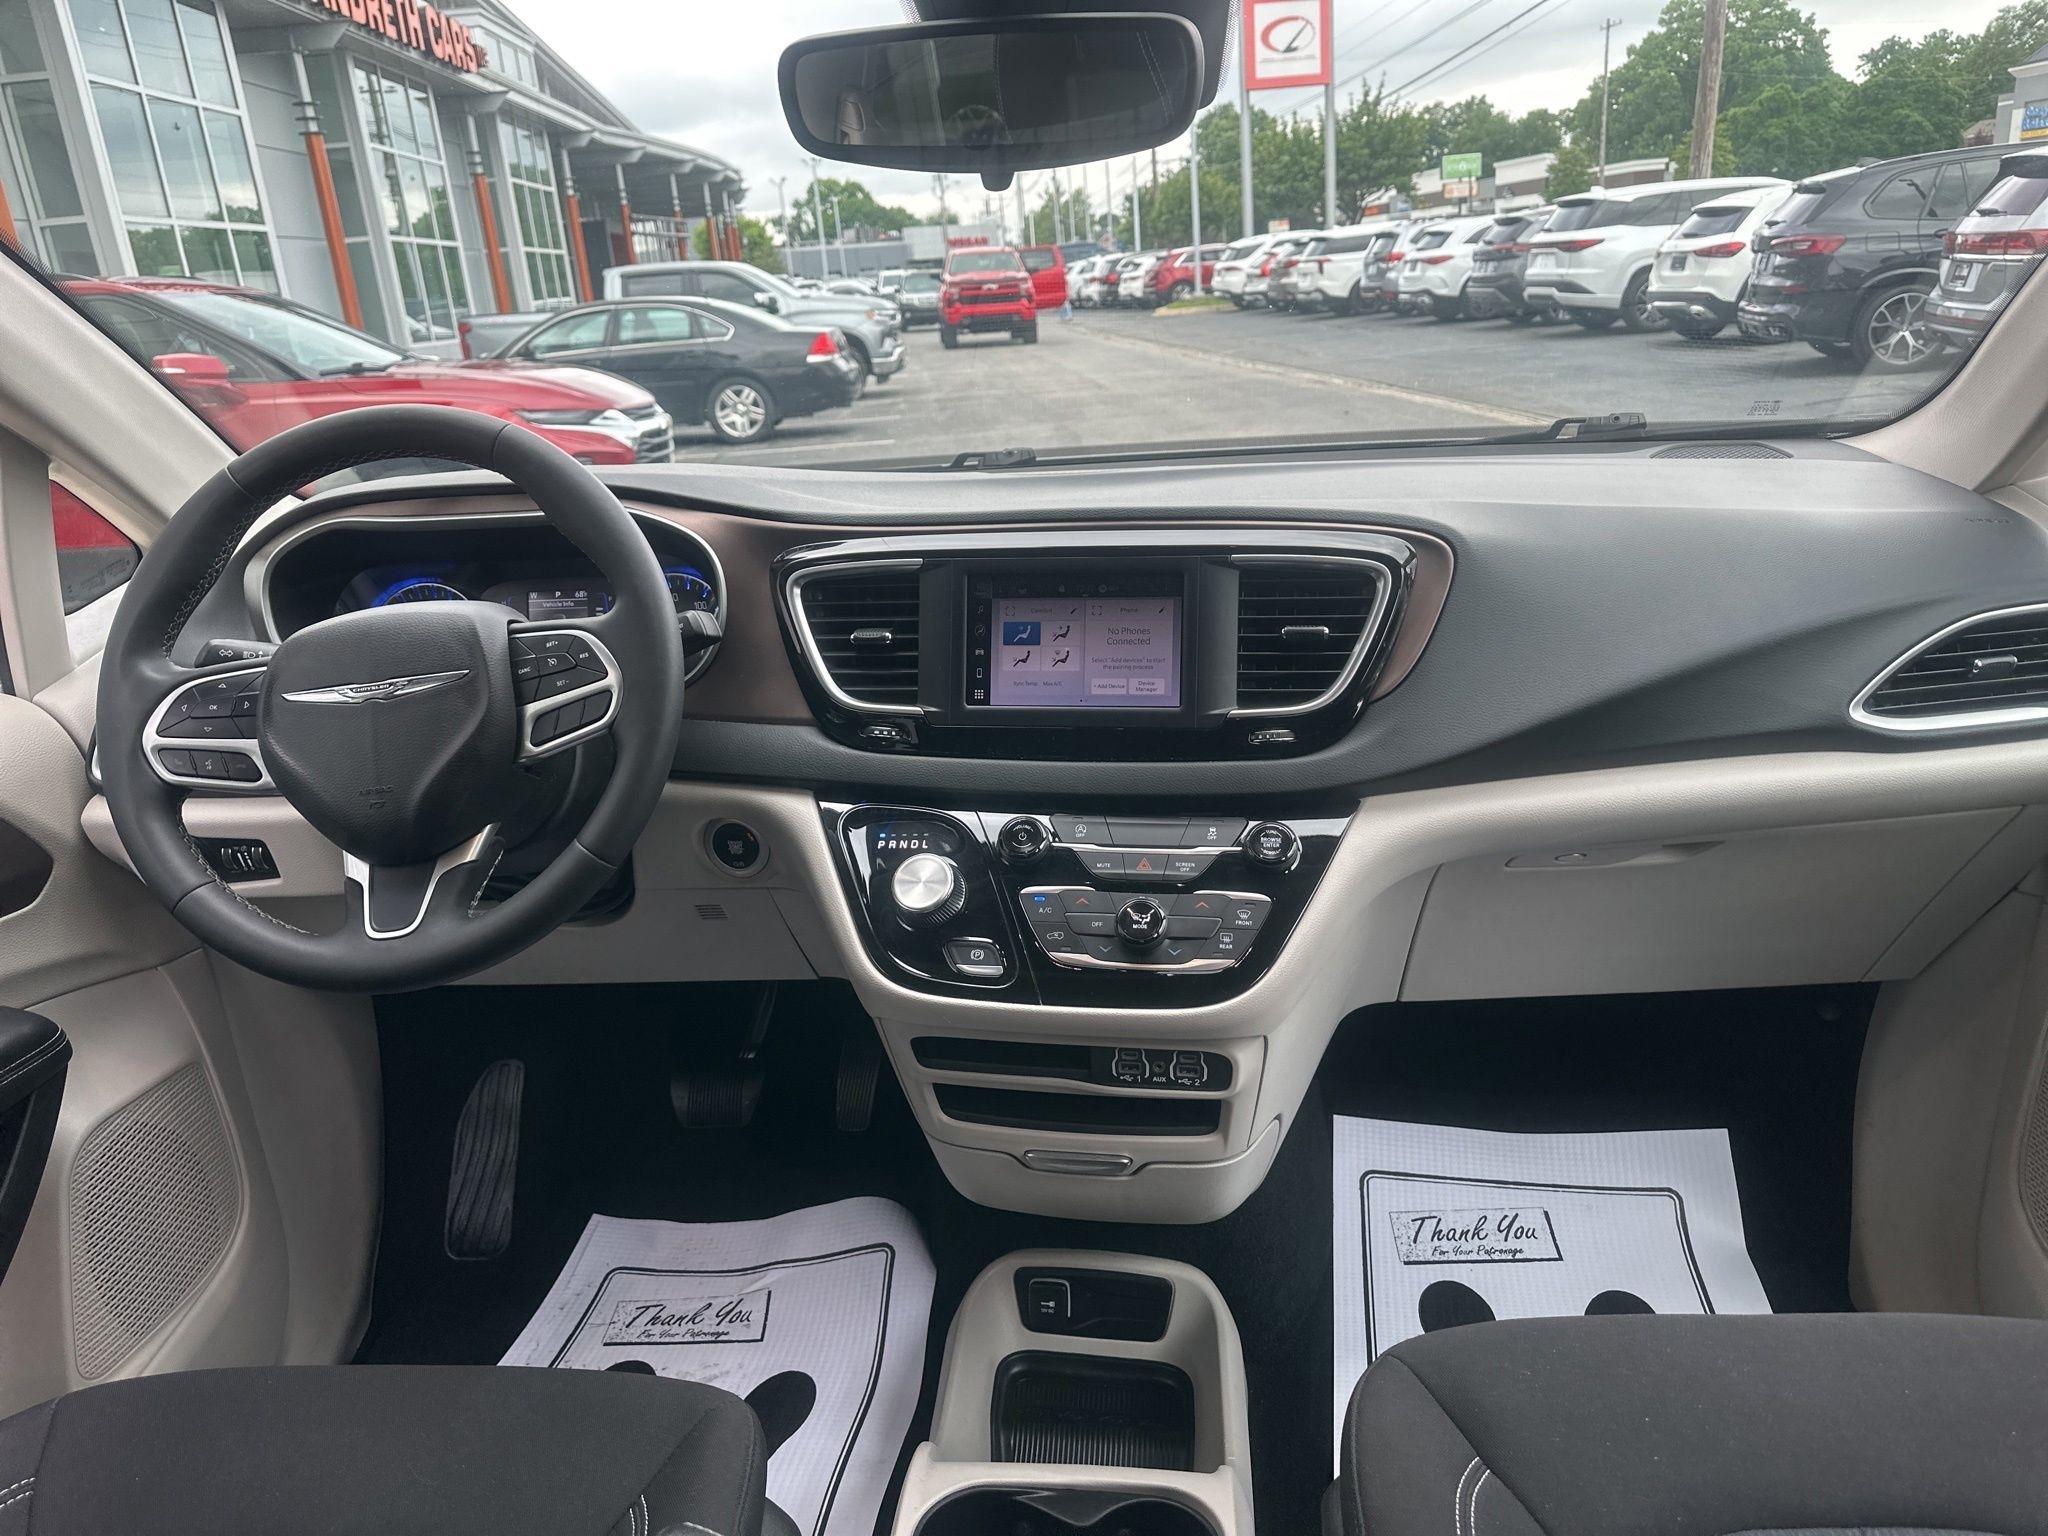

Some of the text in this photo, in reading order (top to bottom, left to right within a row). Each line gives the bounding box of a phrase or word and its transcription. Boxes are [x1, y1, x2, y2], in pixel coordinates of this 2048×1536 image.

[425, 3, 478, 73] CARS
[694, 601, 707, 610] 100
[1121, 627, 1151, 635] Phones
[1106, 637, 1151, 645] Connected
[352, 683, 390, 693] CHRYSLER
[1411, 1213, 1538, 1244] Thank You
[1431, 1244, 1525, 1259] For Your Patronage
[625, 1298, 752, 1329] Thank You
[636, 1328, 730, 1339] For Your Patronage
